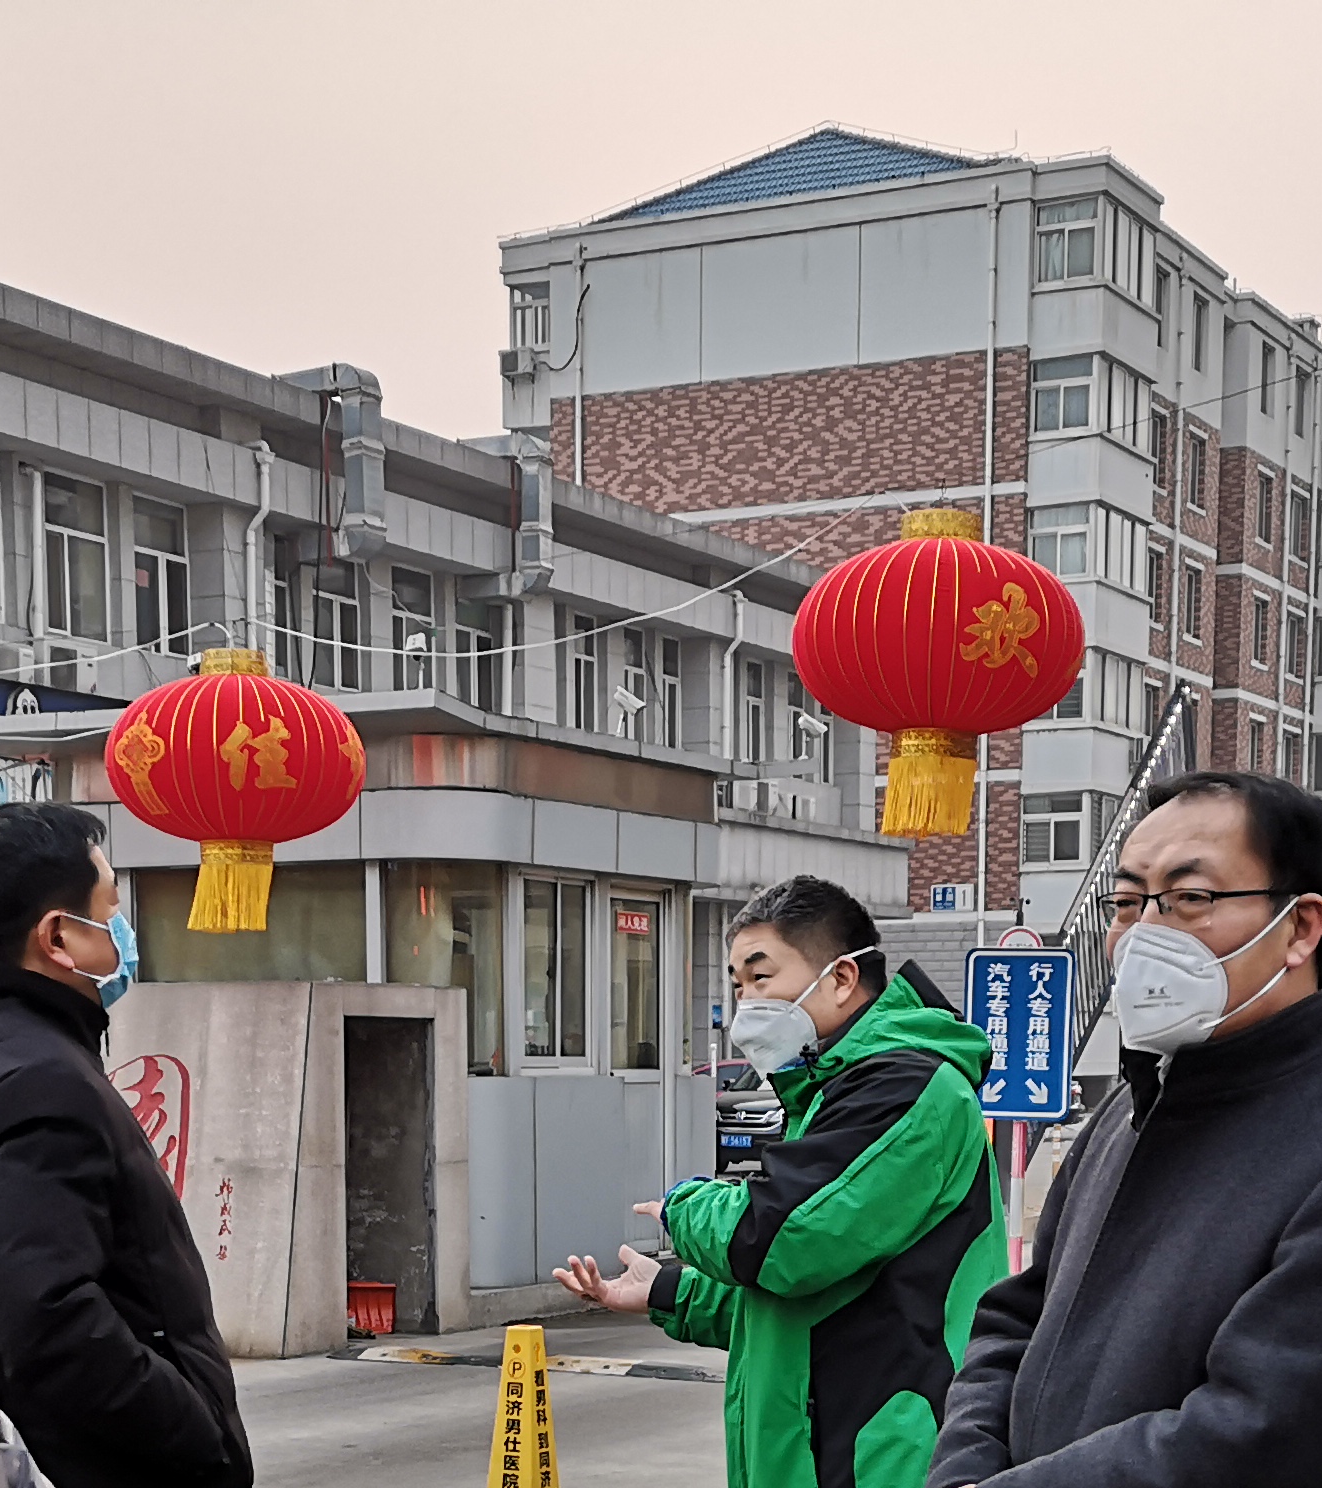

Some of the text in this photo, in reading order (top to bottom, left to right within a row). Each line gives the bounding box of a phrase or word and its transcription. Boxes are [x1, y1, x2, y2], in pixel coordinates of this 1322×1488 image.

[220, 714, 298, 792] 佳
[986, 963, 1012, 1071] 汽车专用通道
[1025, 963, 1054, 1071] 行人专用通道
[534, 1369, 547, 1427] 看男科
[538, 1431, 551, 1488] 到同济
